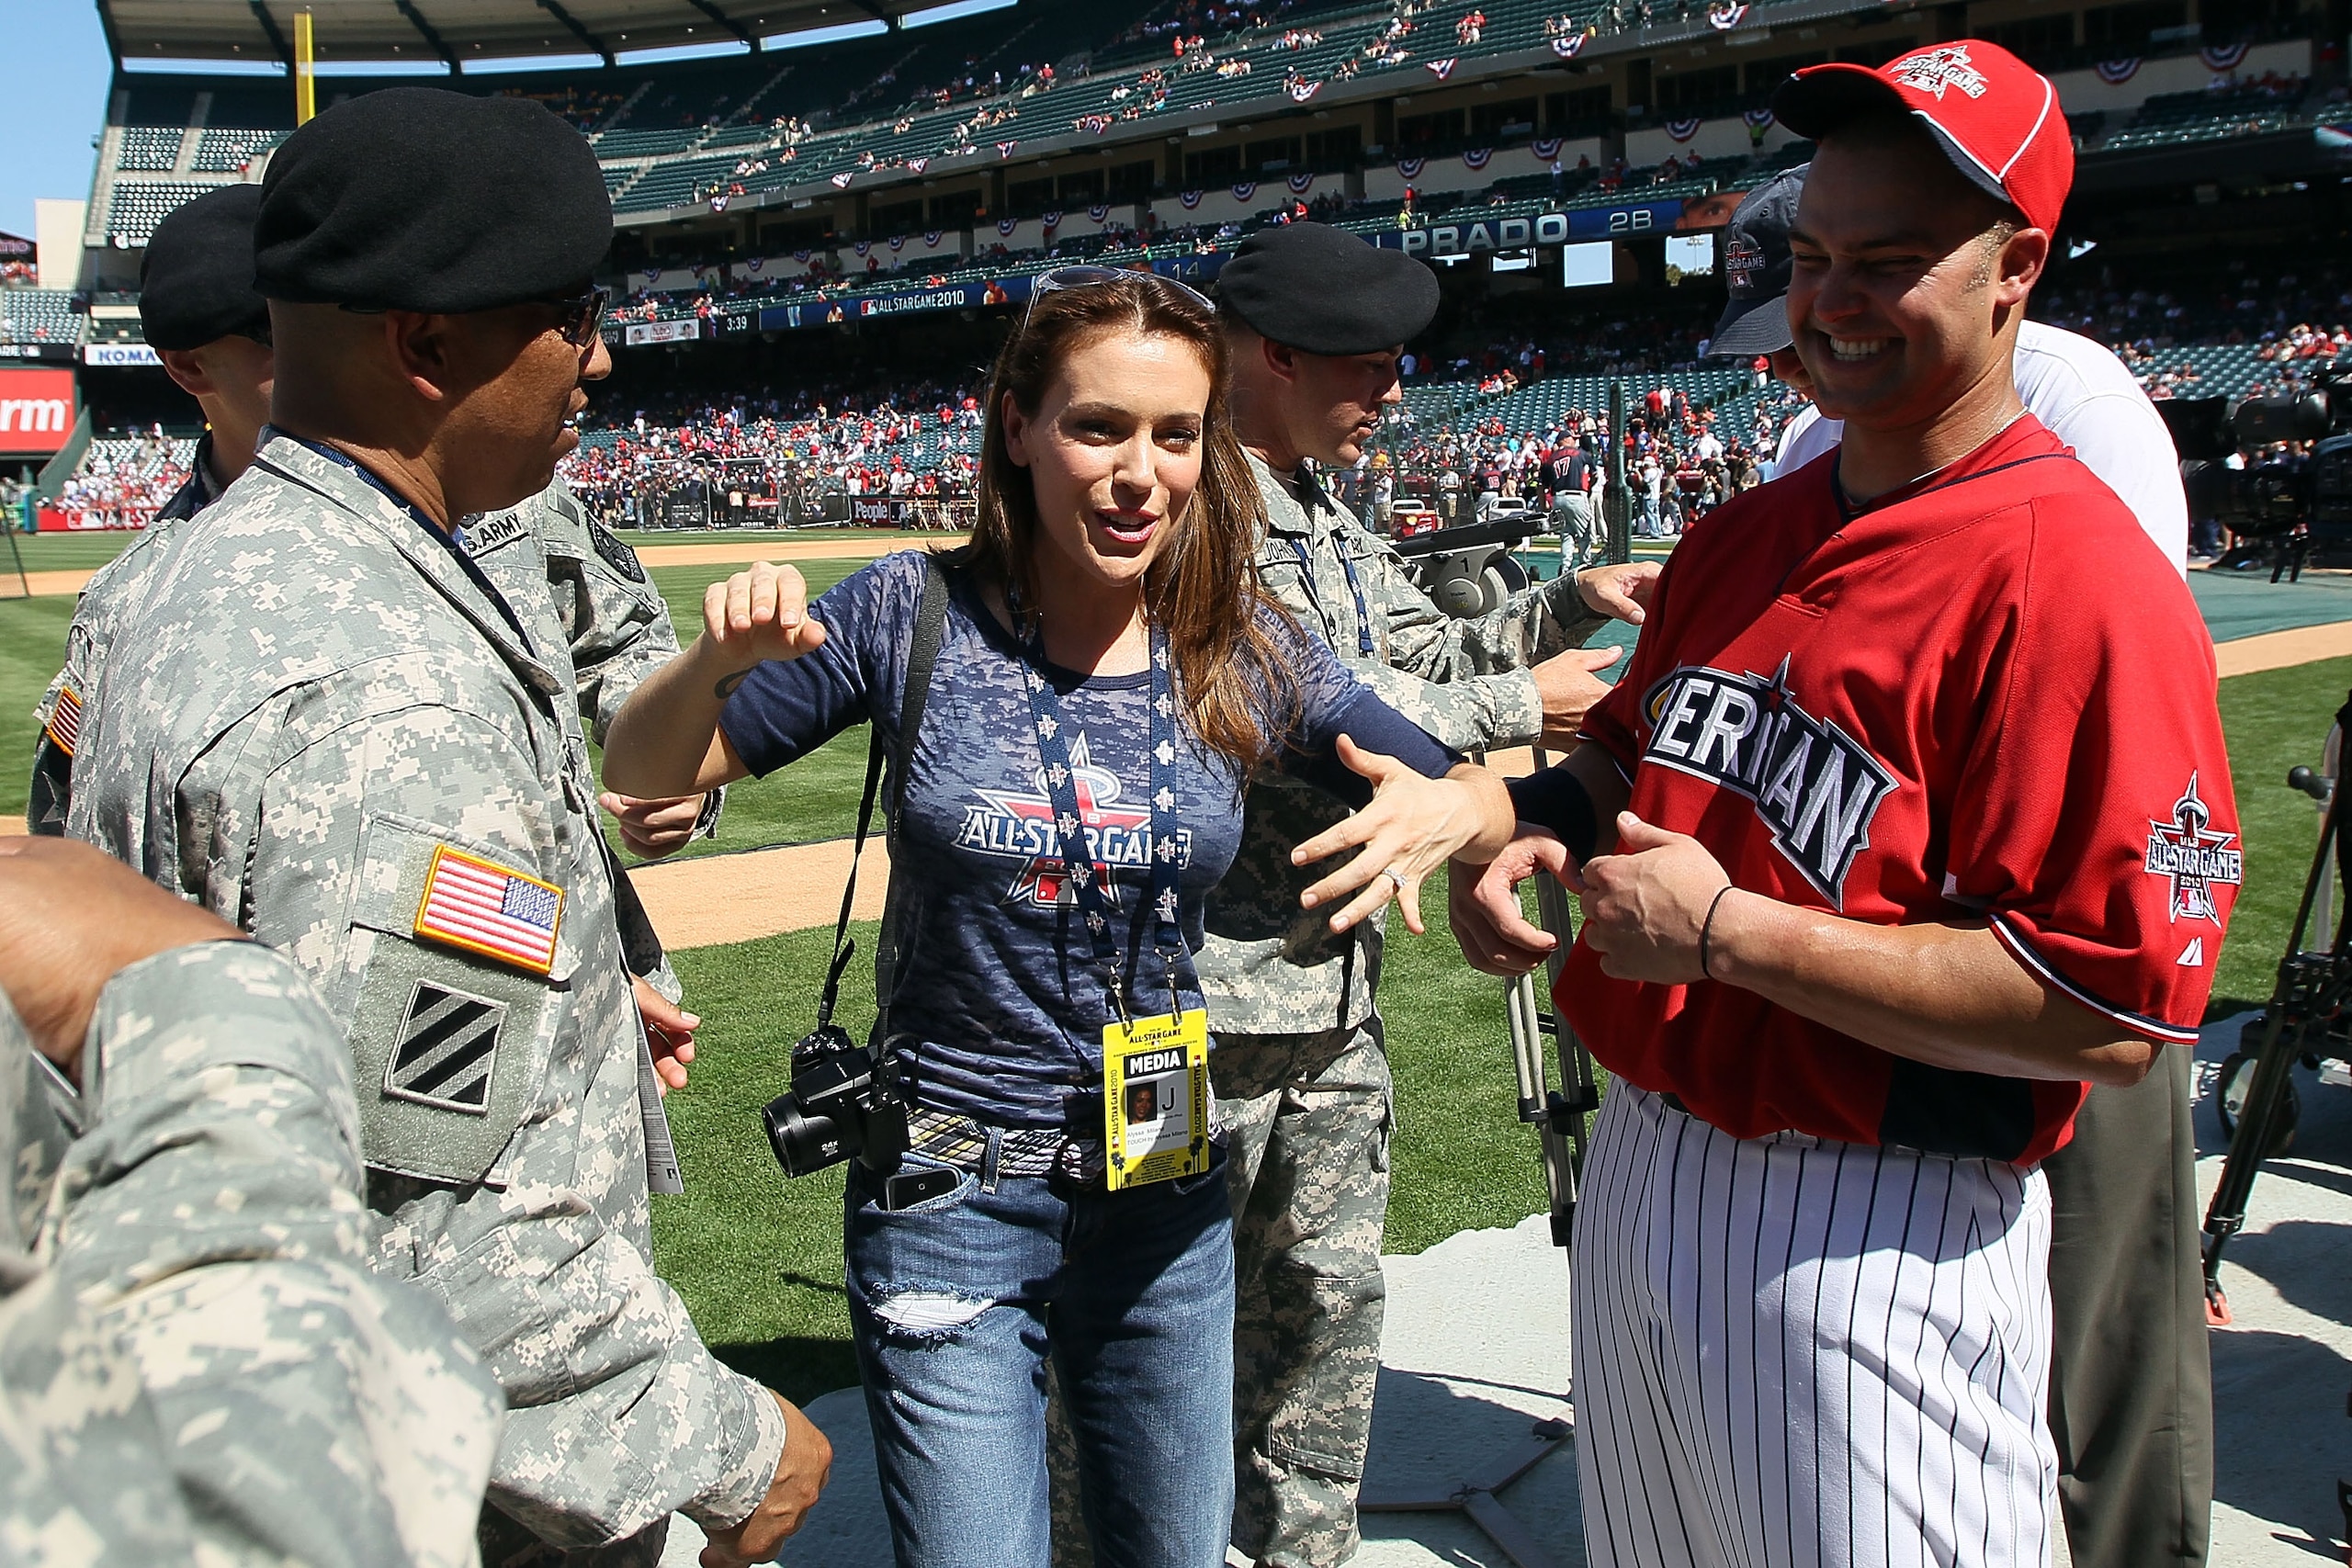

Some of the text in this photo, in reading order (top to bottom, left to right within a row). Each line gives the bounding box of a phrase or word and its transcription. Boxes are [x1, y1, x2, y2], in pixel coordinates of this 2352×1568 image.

[1401, 213, 1568, 255] PRADO
[1610, 209, 1653, 232] 2B
[1172, 261, 1200, 280] 14
[937, 289, 965, 308] 2010
[726, 315, 748, 332] 3:39
[1553, 456, 1571, 479] 17
[854, 501, 888, 522] People
[1460, 557, 1470, 573] 1
[1129, 1050, 1182, 1076] MEDIA
[1110, 1068, 1118, 1087] 2010
[1161, 1087, 1175, 1111] J
